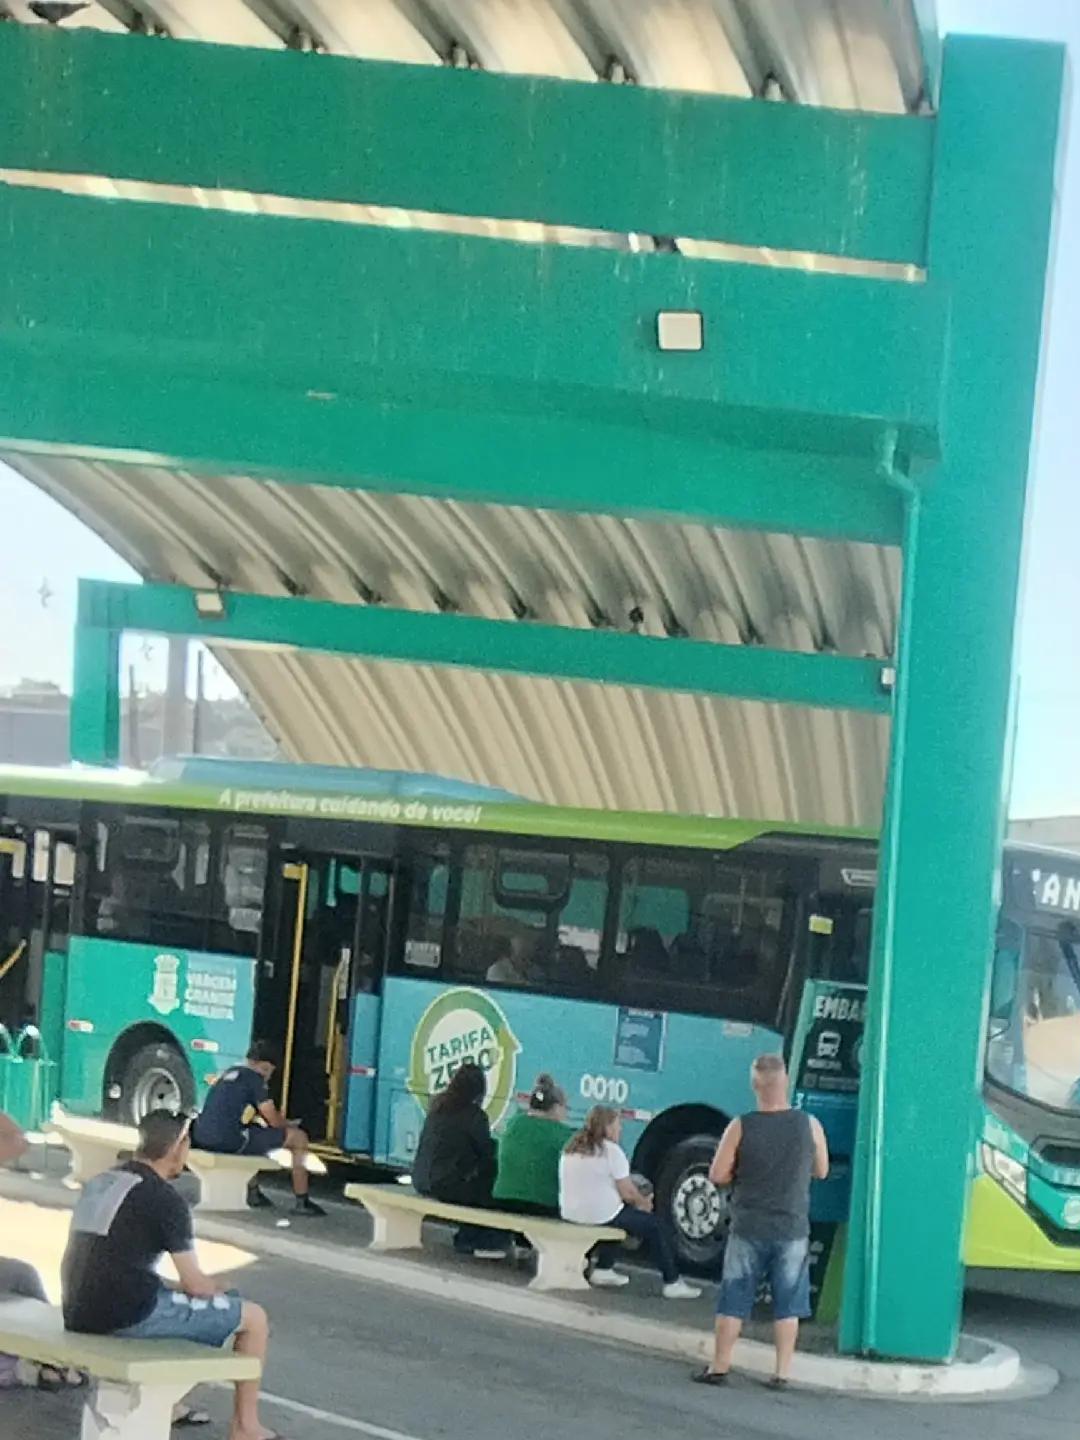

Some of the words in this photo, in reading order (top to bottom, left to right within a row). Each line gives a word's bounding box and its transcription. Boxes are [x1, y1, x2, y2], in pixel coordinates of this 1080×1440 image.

[219, 787, 232, 807] A
[235, 789, 316, 812] prefeitura
[319, 795, 400, 818] cuidando
[404, 801, 427, 820] de
[427, 1027, 492, 1063] TARIFA
[580, 1073, 628, 1103] 0010
